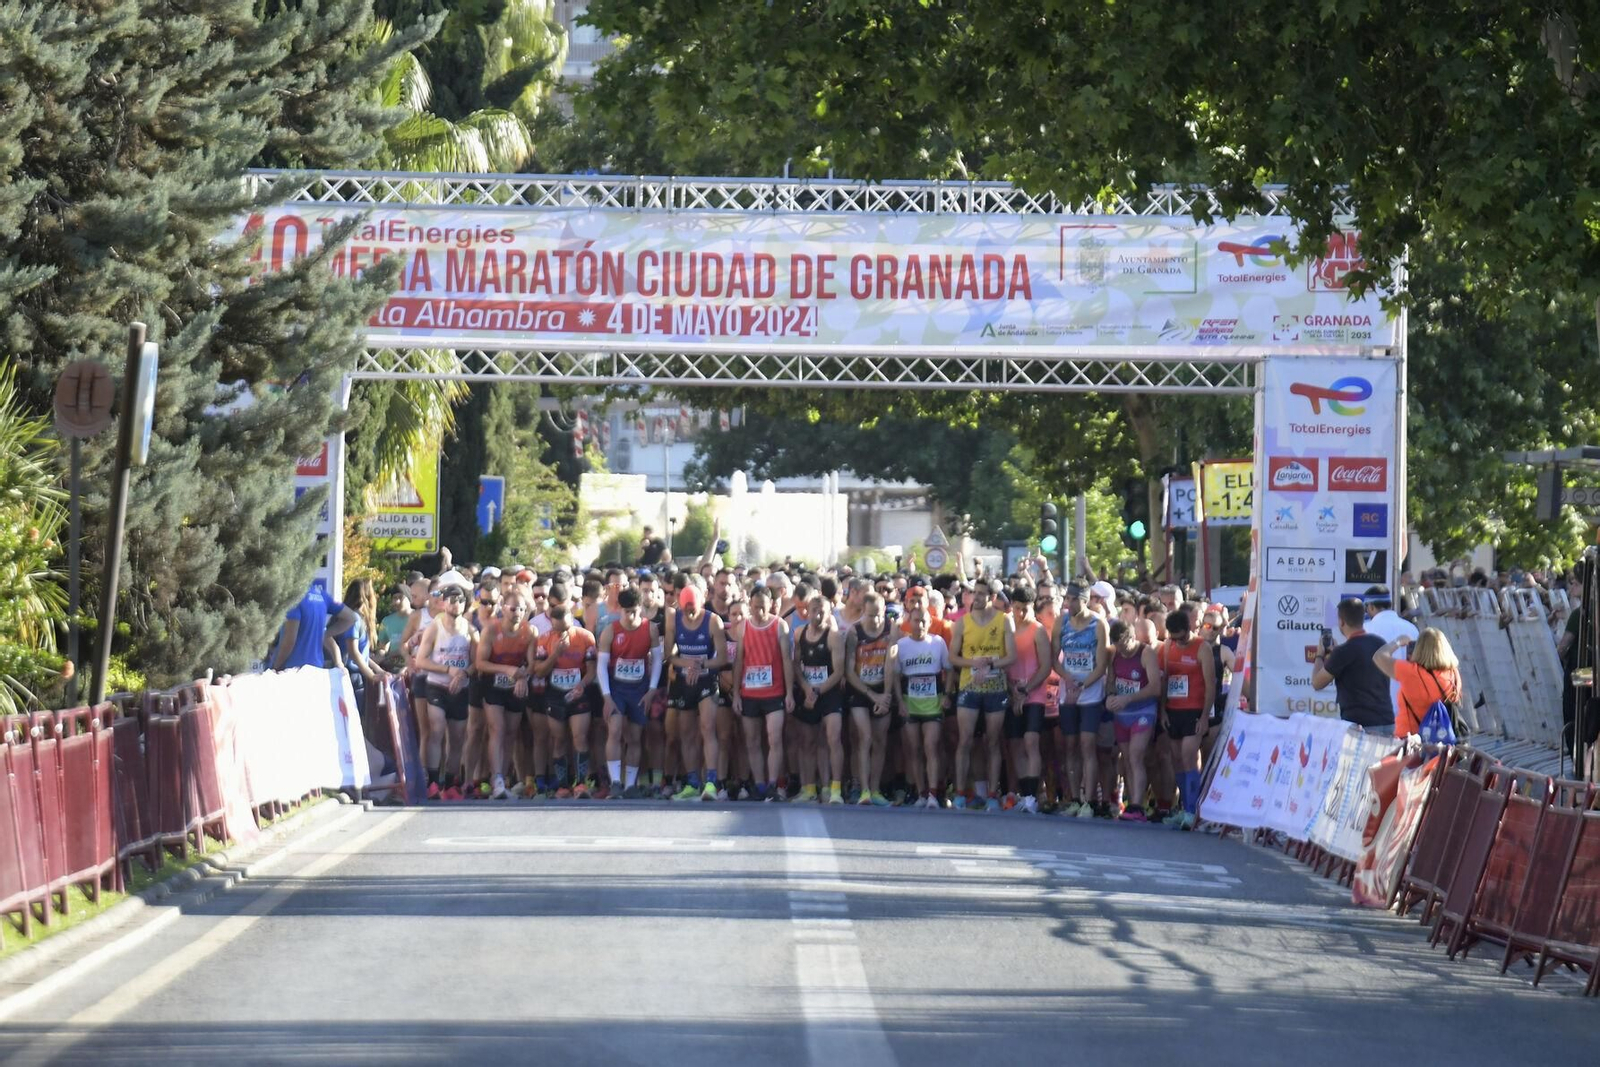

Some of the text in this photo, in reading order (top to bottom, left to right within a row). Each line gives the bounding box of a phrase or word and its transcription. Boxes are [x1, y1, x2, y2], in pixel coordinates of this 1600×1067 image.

[316, 217, 515, 248] TtalEnergies
[445, 240, 624, 296] MARATÓN
[636, 250, 776, 297] CIUDAD
[789, 253, 837, 299] DE
[850, 253, 1032, 300] GRANADA
[1217, 273, 1287, 284] TotalEnergies
[378, 300, 818, 337] la Alhambra 4 DE MAYO 2024
[1304, 315, 1371, 326] GRANADA
[1351, 331, 1372, 339] 2031
[1289, 422, 1372, 437] TotalEnergies
[372, 515, 426, 523] ALIDA DE
[1277, 557, 1326, 566] AEDAS
[1277, 620, 1323, 631] Gilauto
[1067, 657, 1088, 667] 5342
[617, 664, 641, 674] 2414
[553, 674, 577, 683] 5117
[746, 671, 768, 681] 4712
[910, 683, 932, 692] 4927
